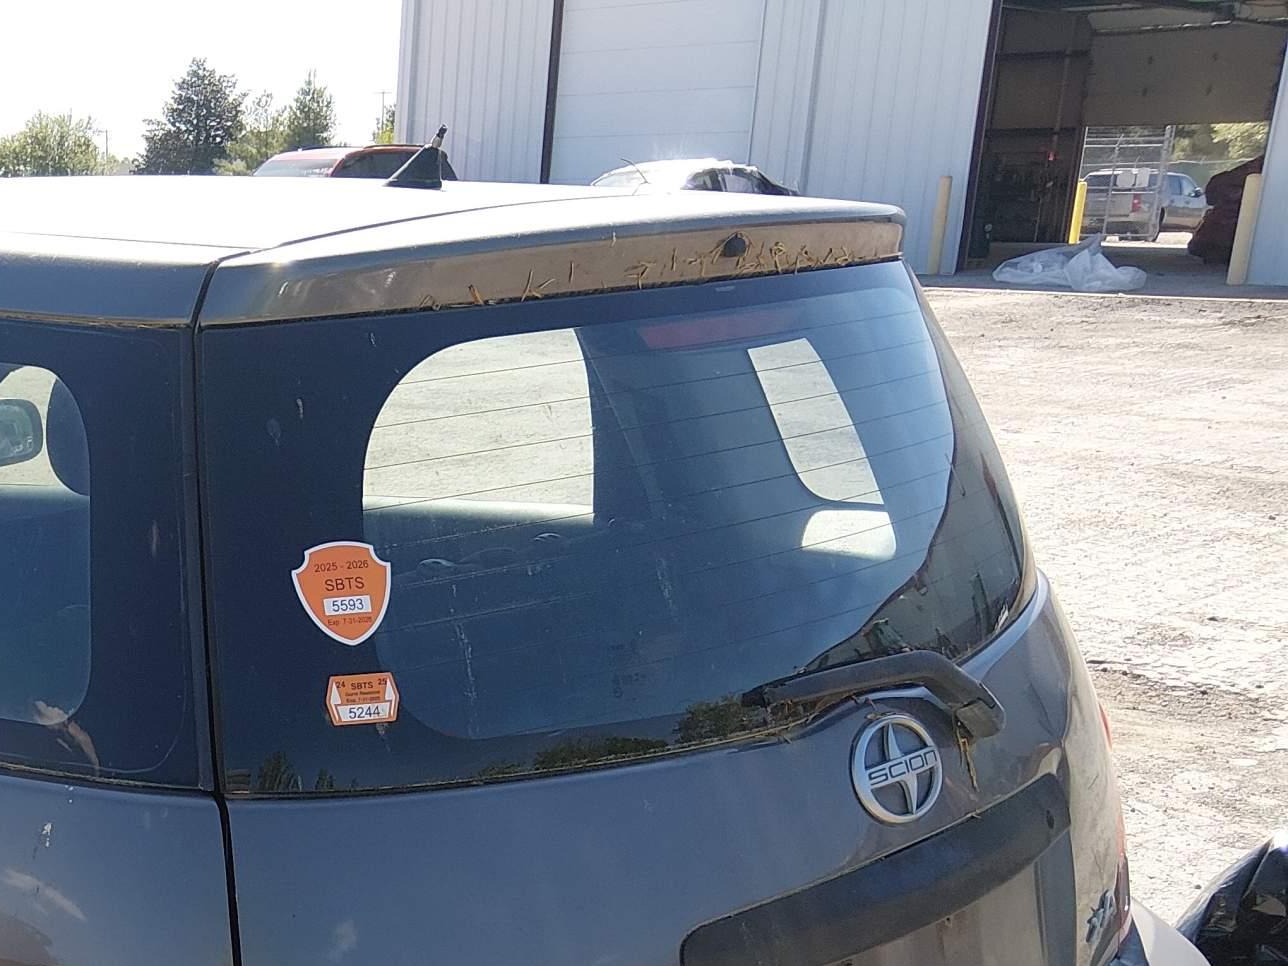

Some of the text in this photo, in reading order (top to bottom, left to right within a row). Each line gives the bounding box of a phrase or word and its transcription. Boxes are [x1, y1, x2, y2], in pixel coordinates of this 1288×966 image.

[314, 562, 338, 573] 2025
[345, 559, 369, 570] 2026
[324, 576, 365, 592] SBTS
[331, 598, 364, 613] 5593
[350, 681, 374, 690] SBTS
[348, 705, 381, 719] 5244
[868, 749, 938, 786] SCION
